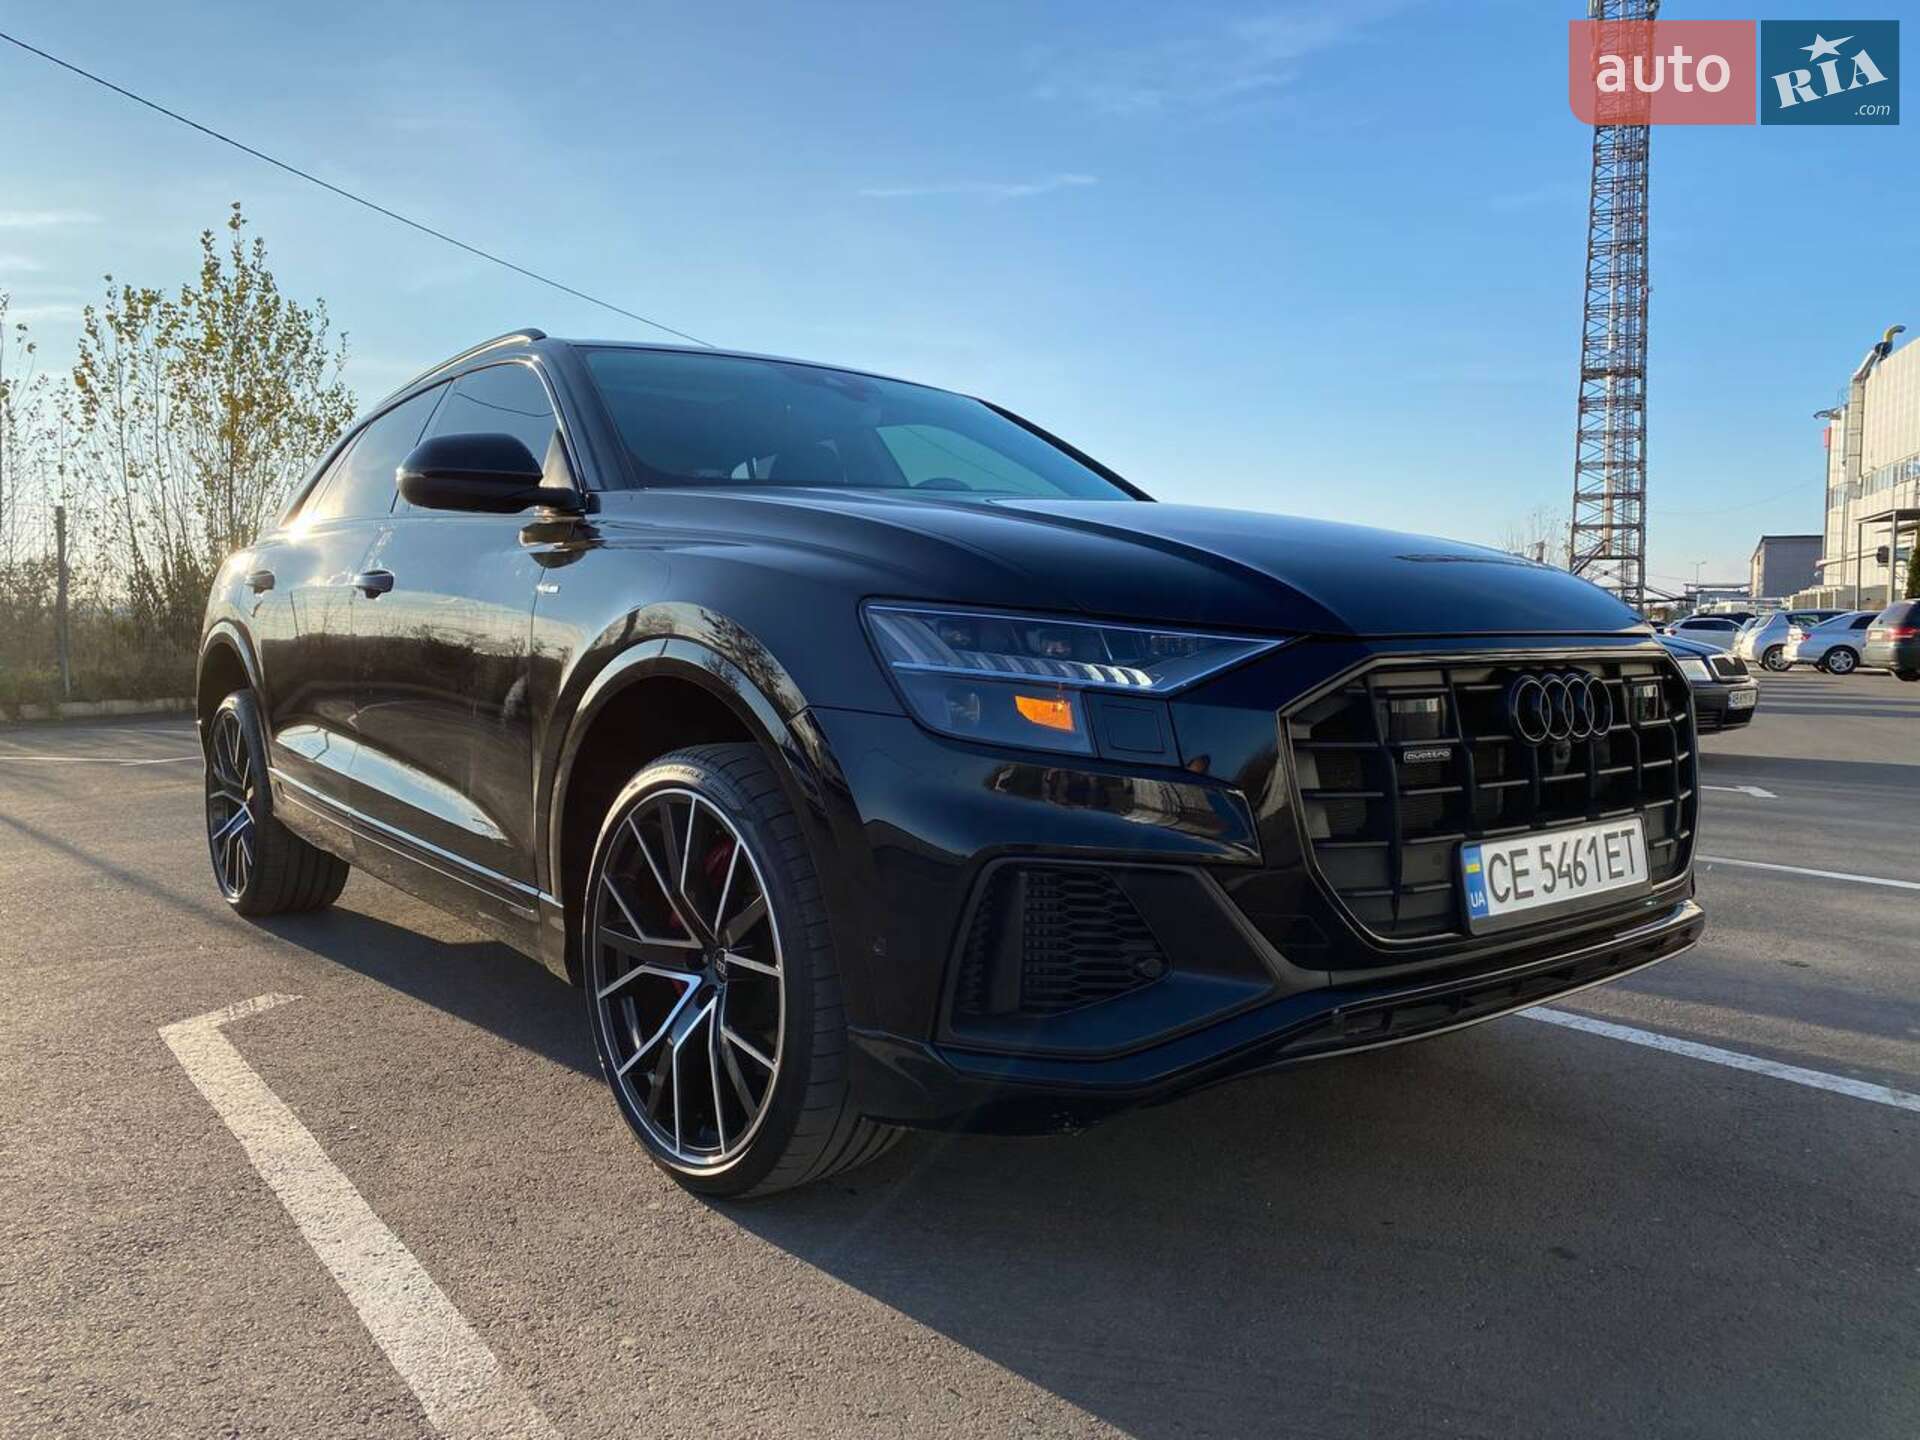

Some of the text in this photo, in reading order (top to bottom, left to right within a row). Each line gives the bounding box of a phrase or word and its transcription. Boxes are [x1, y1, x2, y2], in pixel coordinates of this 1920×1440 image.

[1488, 828, 1635, 903] CE 5461 ET
[1470, 892, 1486, 908] UA
